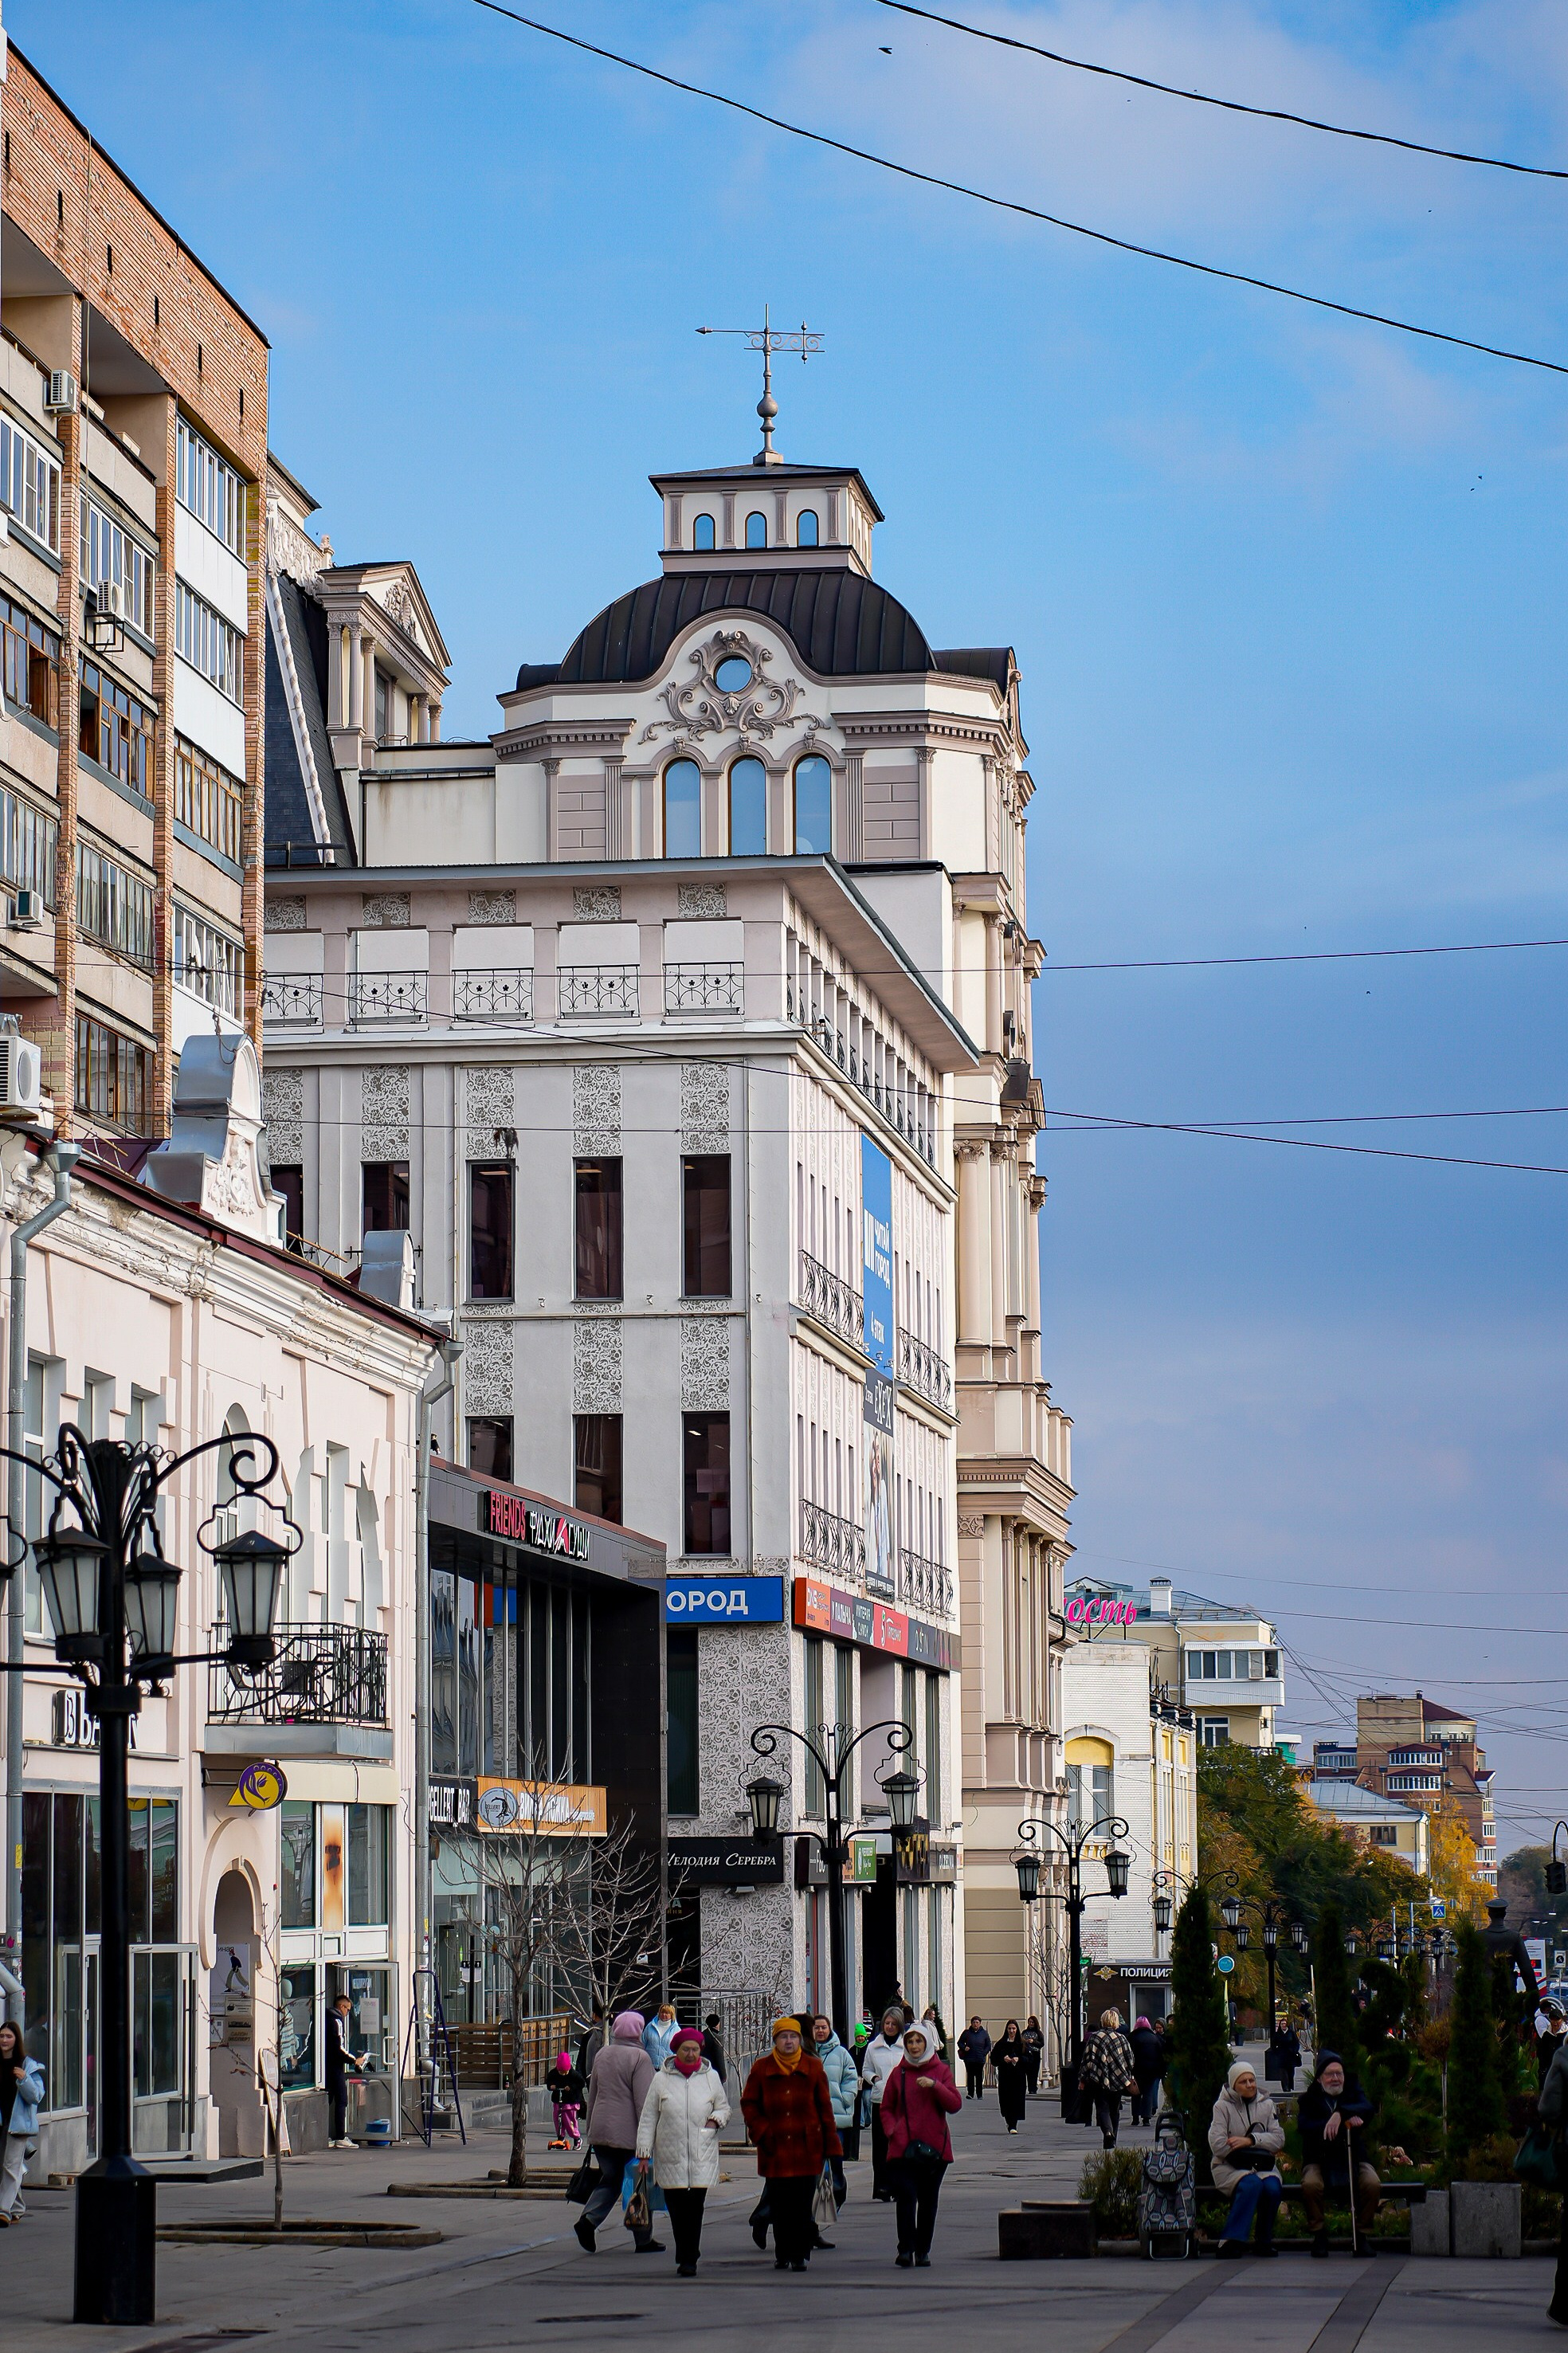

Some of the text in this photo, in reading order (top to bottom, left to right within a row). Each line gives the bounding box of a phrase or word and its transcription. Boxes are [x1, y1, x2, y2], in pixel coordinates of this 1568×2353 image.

[875, 1218, 890, 1254] ЧИТАЙ
[875, 1249, 891, 1290] ГОРОД
[490, 1490, 526, 1541] FRIENDS
[1064, 1597, 1138, 1626] ость
